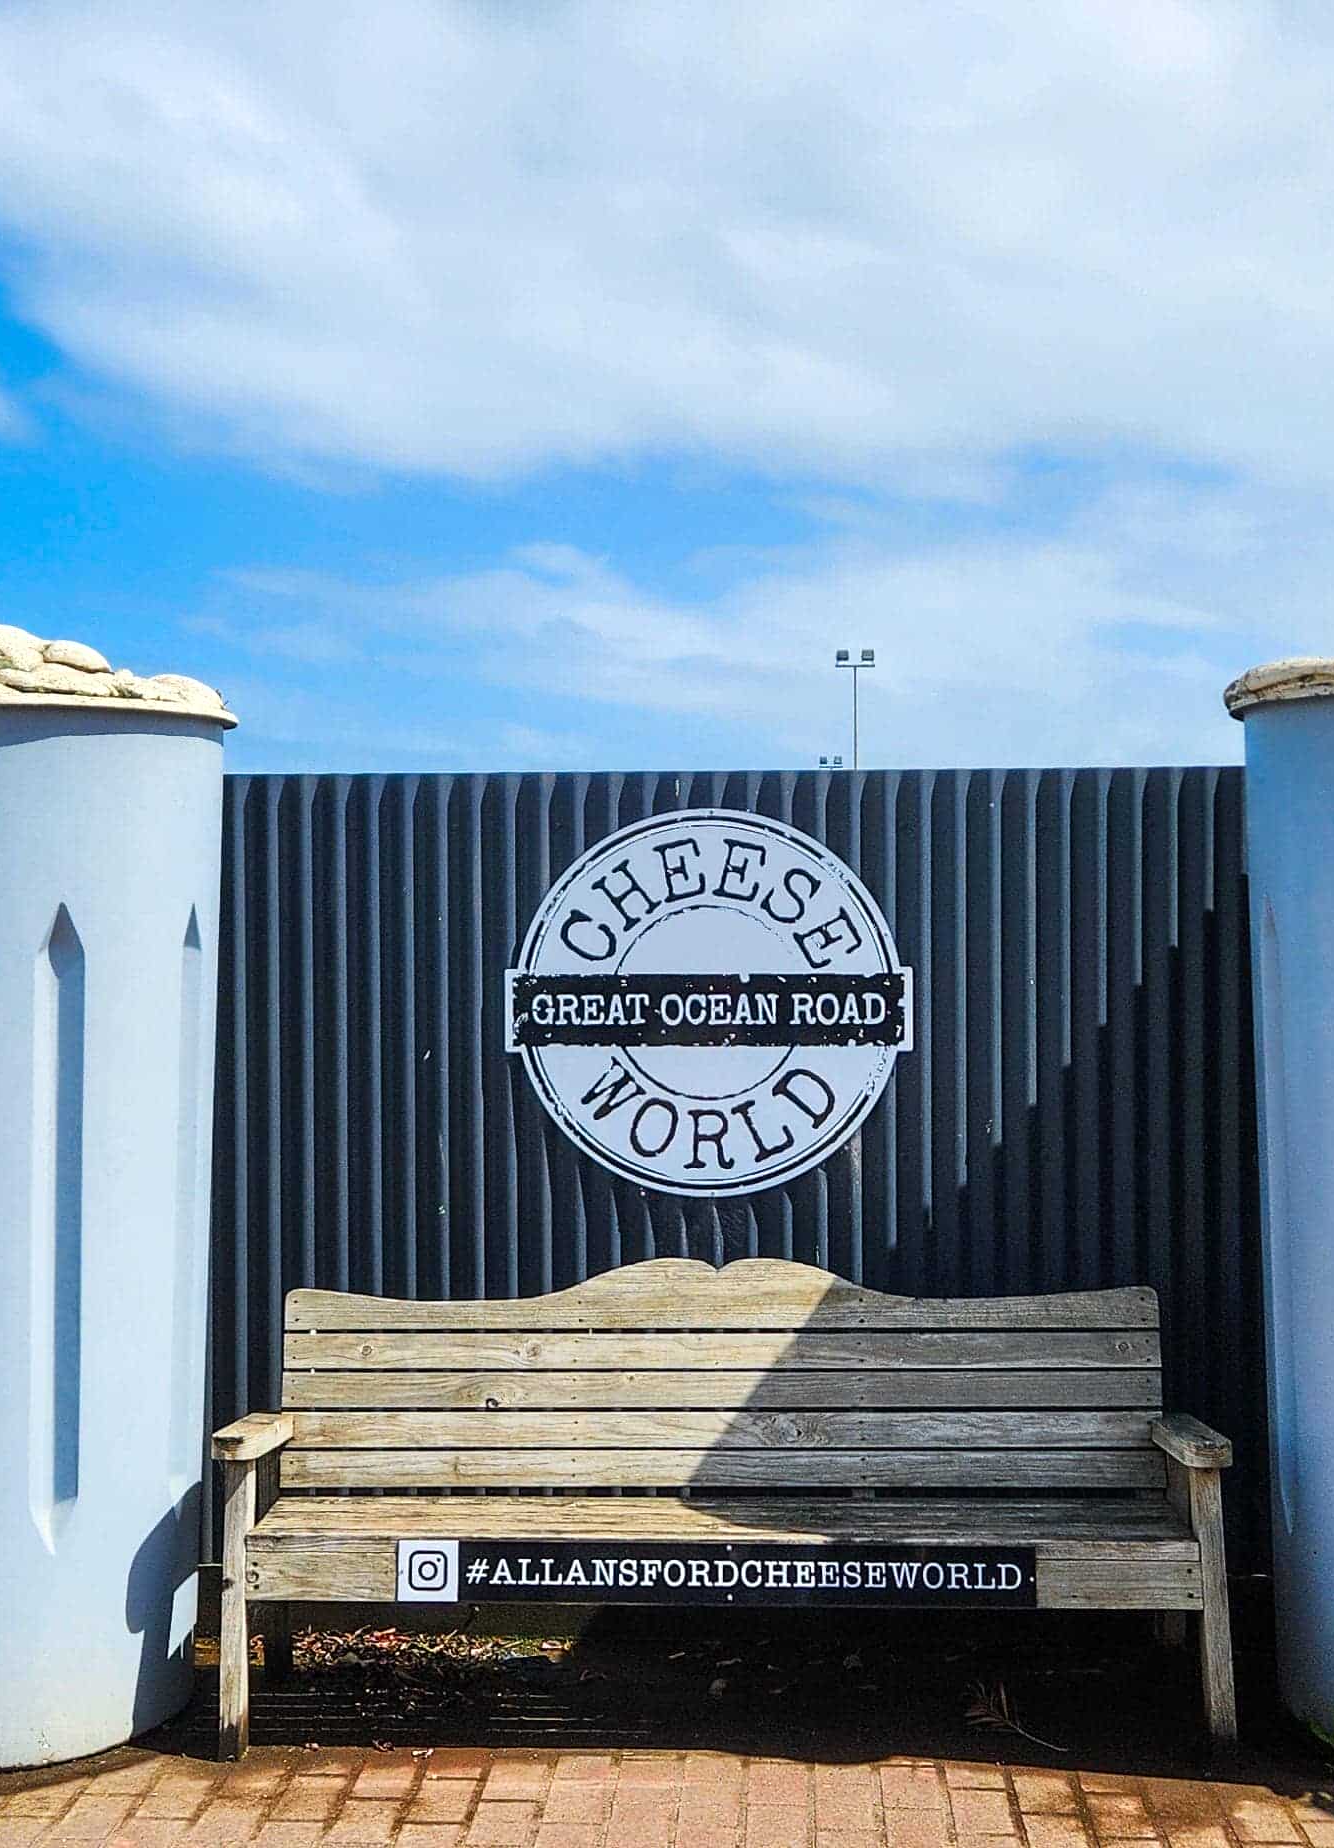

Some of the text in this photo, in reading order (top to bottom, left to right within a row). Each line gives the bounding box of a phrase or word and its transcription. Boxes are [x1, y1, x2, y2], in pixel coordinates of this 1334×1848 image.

[560, 838, 862, 968] CHEESE
[531, 992, 886, 1026] GREAT OCEAN ROAD
[581, 1056, 835, 1169] WORLD
[465, 1558, 1022, 1590] #ALLANSFORDCHEESEWORLD
